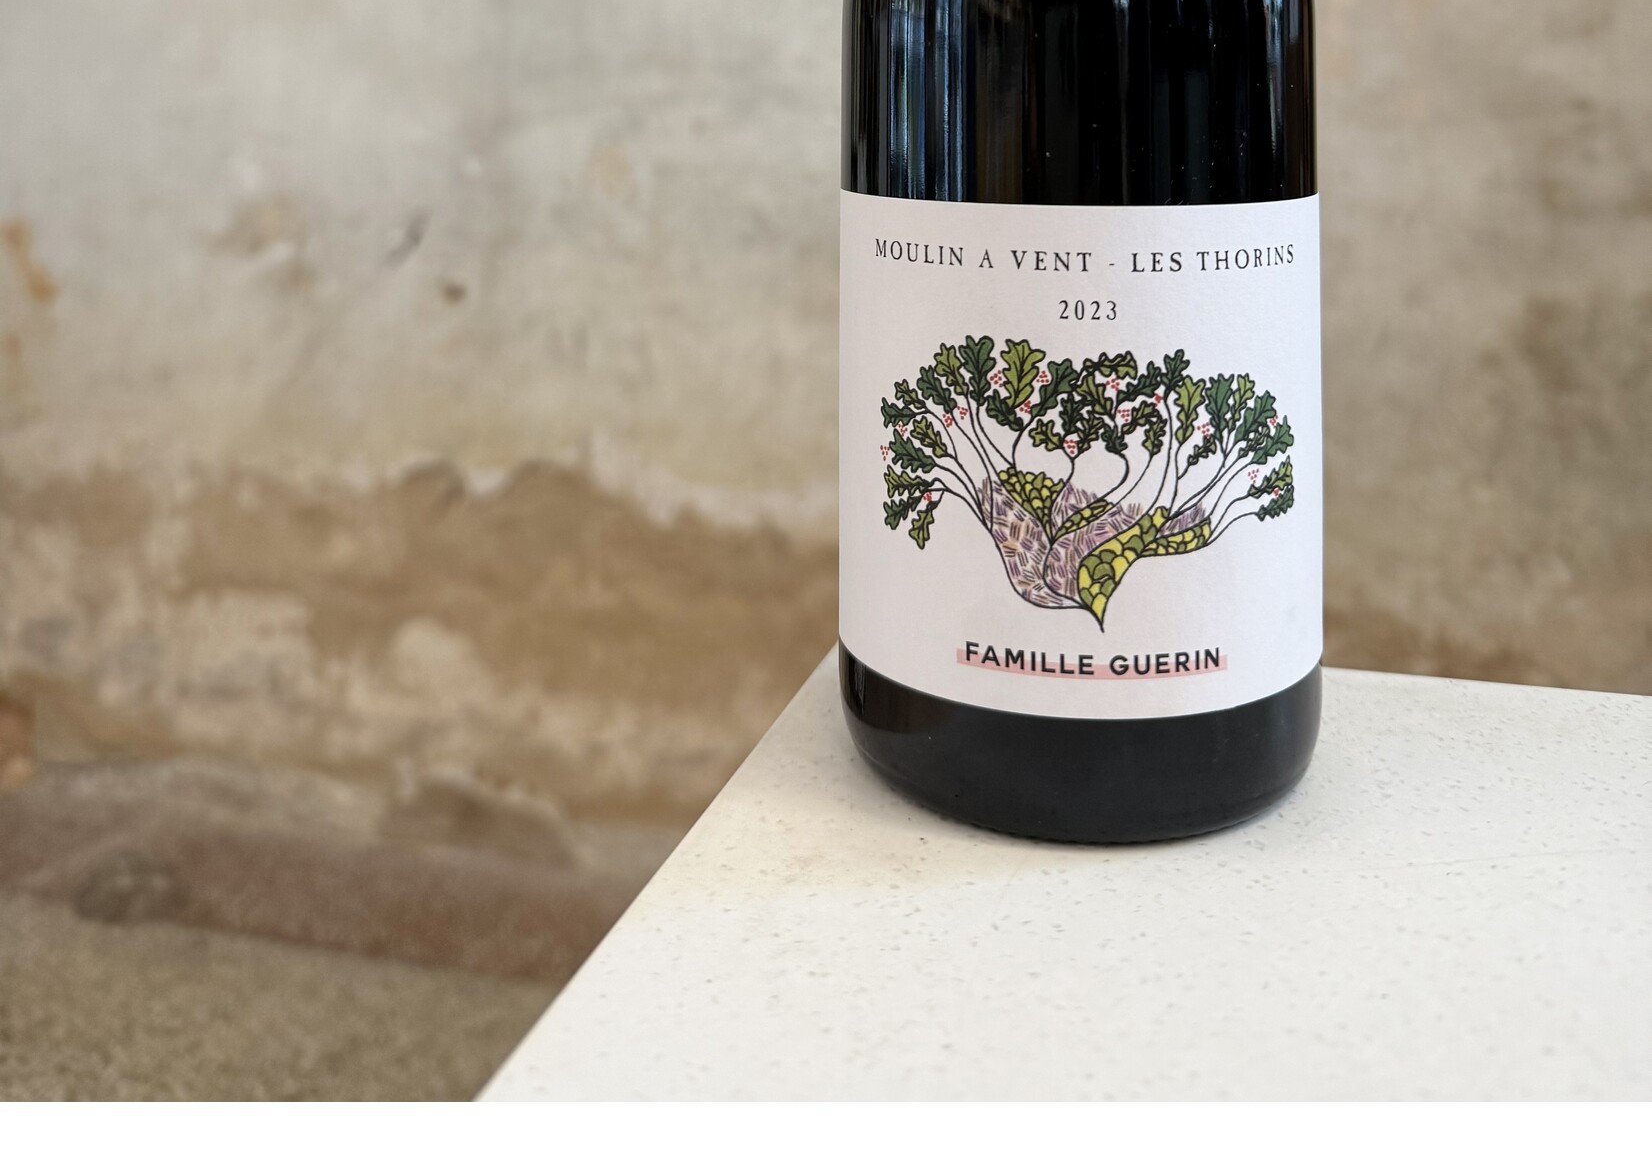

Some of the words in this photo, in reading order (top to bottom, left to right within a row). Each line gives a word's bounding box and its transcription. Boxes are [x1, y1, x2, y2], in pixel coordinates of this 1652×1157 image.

[875, 237, 964, 267] MOULIN
[978, 248, 995, 269] A
[1009, 249, 1093, 273] VENT
[1130, 251, 1183, 273] LES
[1196, 243, 1294, 272] THORINS
[1058, 299, 1117, 321] 2023
[965, 640, 1095, 676] FAMILLE
[1108, 647, 1220, 677] GUERIN
